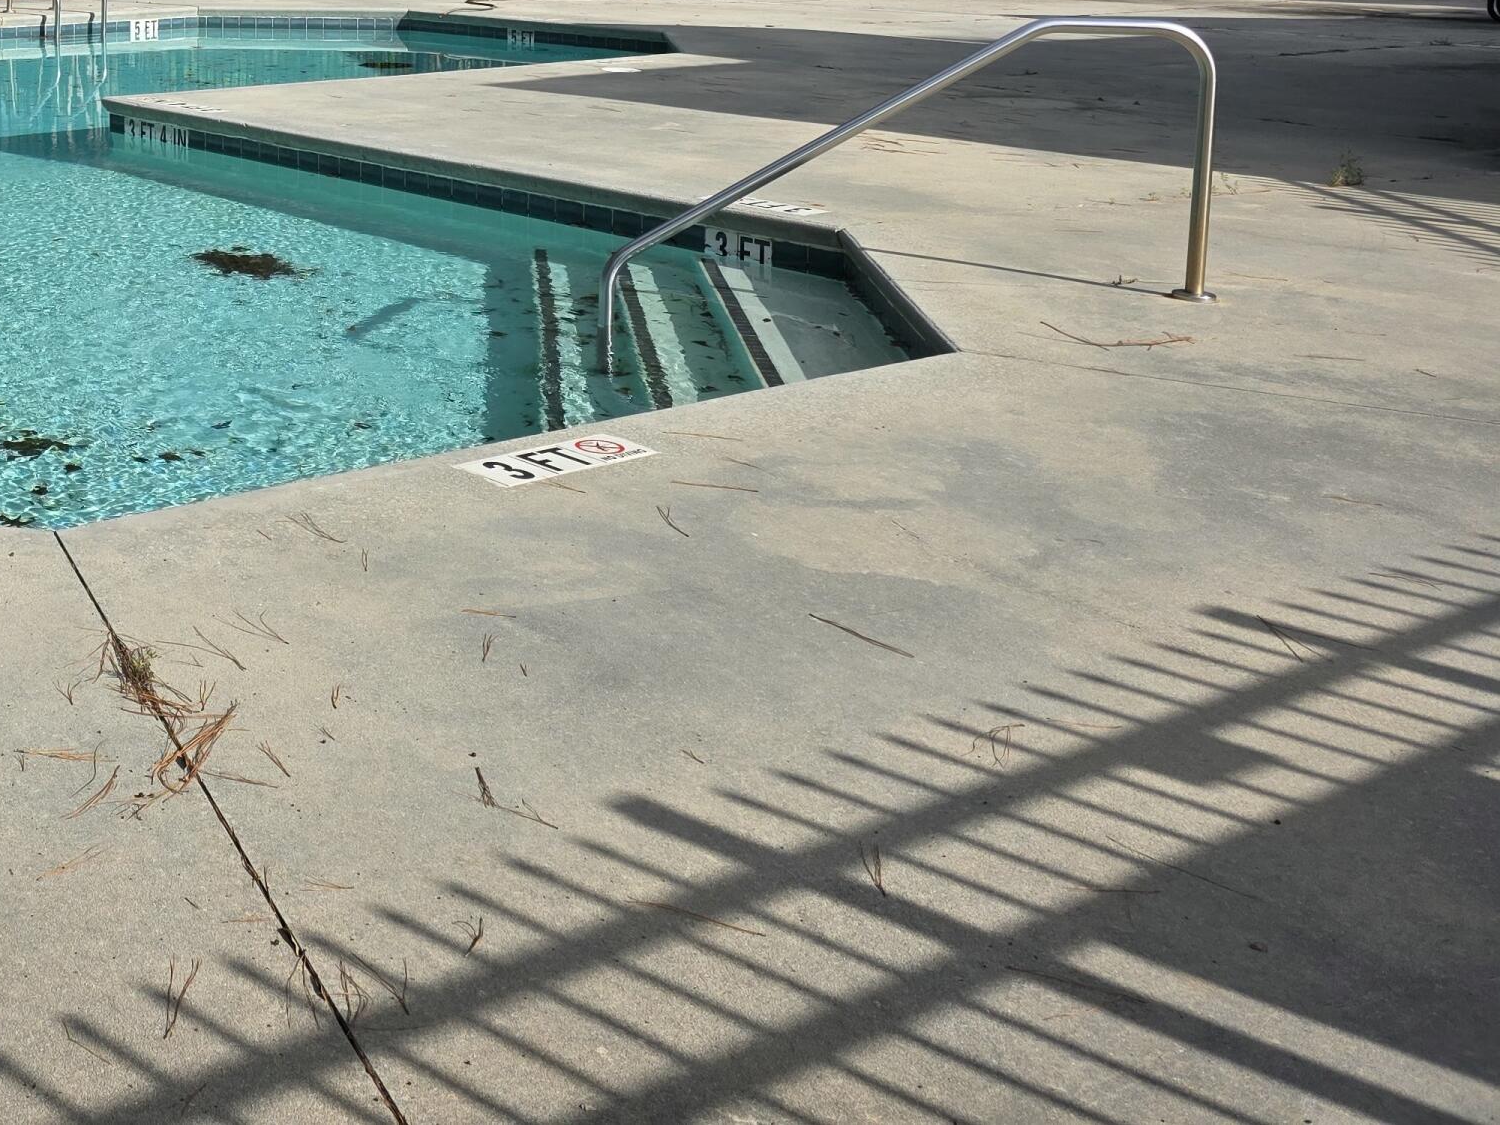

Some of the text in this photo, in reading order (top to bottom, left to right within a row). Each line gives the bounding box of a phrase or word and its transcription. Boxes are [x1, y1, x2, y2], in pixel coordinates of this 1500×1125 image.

[173, 128, 186, 147] IN
[715, 231, 771, 264] 3 FT
[482, 447, 592, 479] 3 FT
